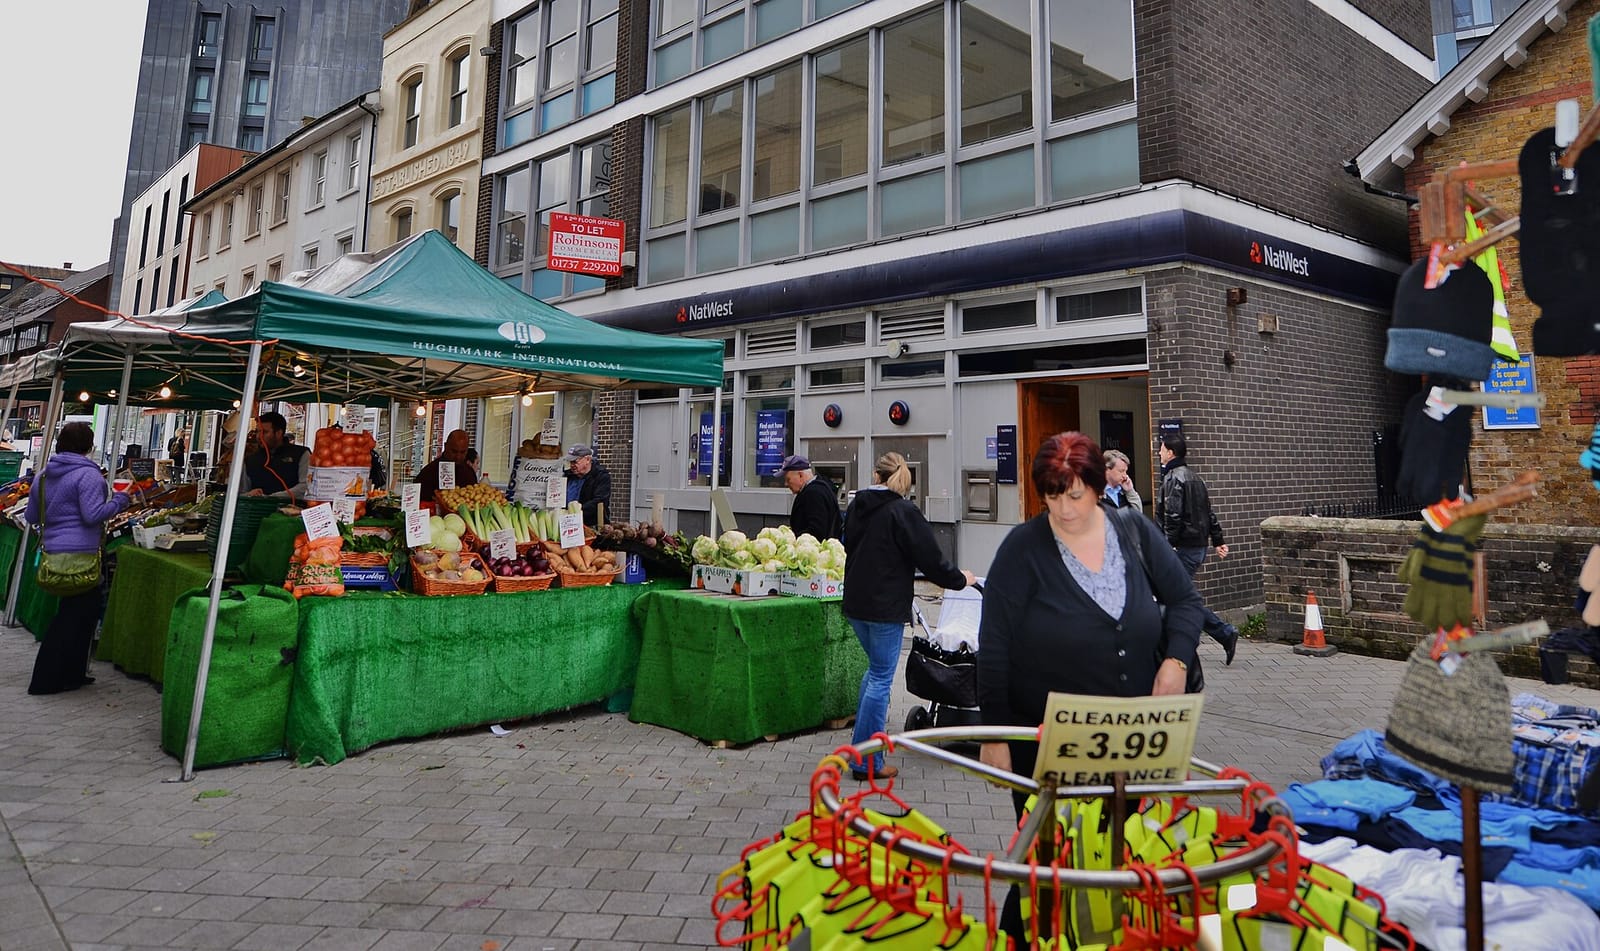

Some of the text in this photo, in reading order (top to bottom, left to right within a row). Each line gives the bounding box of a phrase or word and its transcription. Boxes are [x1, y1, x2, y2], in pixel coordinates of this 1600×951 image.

[571, 223, 605, 235] TO LET
[578, 217, 597, 225] FLOOR
[597, 219, 621, 227] OFFICES
[555, 232, 619, 251] Robinsons
[554, 246, 618, 256] COMMERCIAL
[551, 258, 619, 274] 01737 229200
[1263, 245, 1310, 277] NatWest
[689, 299, 734, 321] NatWest
[412, 341, 502, 359] HUGHMARK
[512, 352, 624, 371] INTERNATIONAL
[522, 474, 549, 485] potat
[343, 572, 366, 580] Parsnip
[705, 567, 732, 581] PINEAPPLES
[1055, 710, 1190, 725] CLEARANCE
[1087, 731, 1169, 759] 3.99
